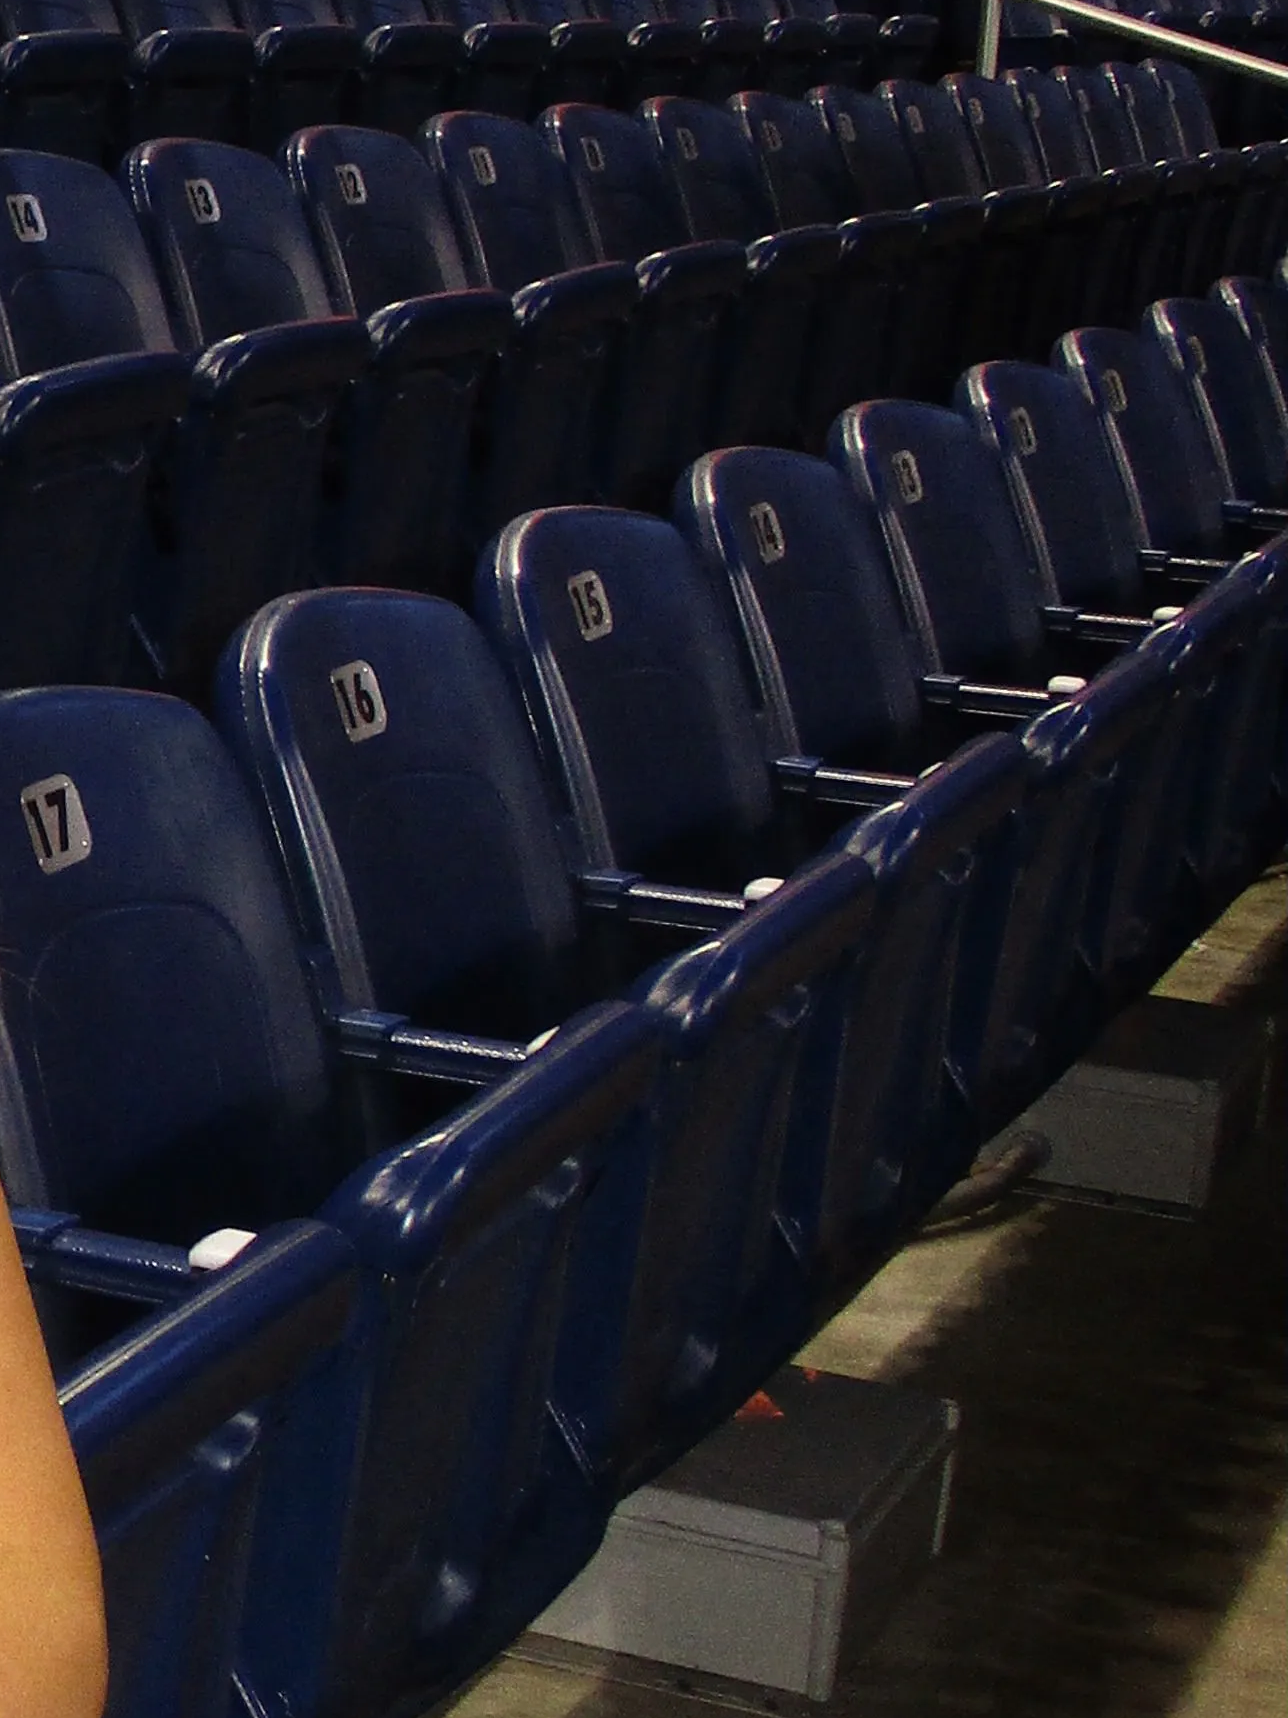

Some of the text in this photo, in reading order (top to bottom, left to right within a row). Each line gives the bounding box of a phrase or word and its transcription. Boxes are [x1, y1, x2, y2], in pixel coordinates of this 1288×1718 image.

[190, 185, 213, 218] 13
[340, 171, 361, 199] 12
[12, 201, 39, 235] 14
[754, 511, 779, 555] 14
[573, 580, 604, 630] 15
[338, 673, 375, 730] 16
[25, 787, 69, 859] 17
